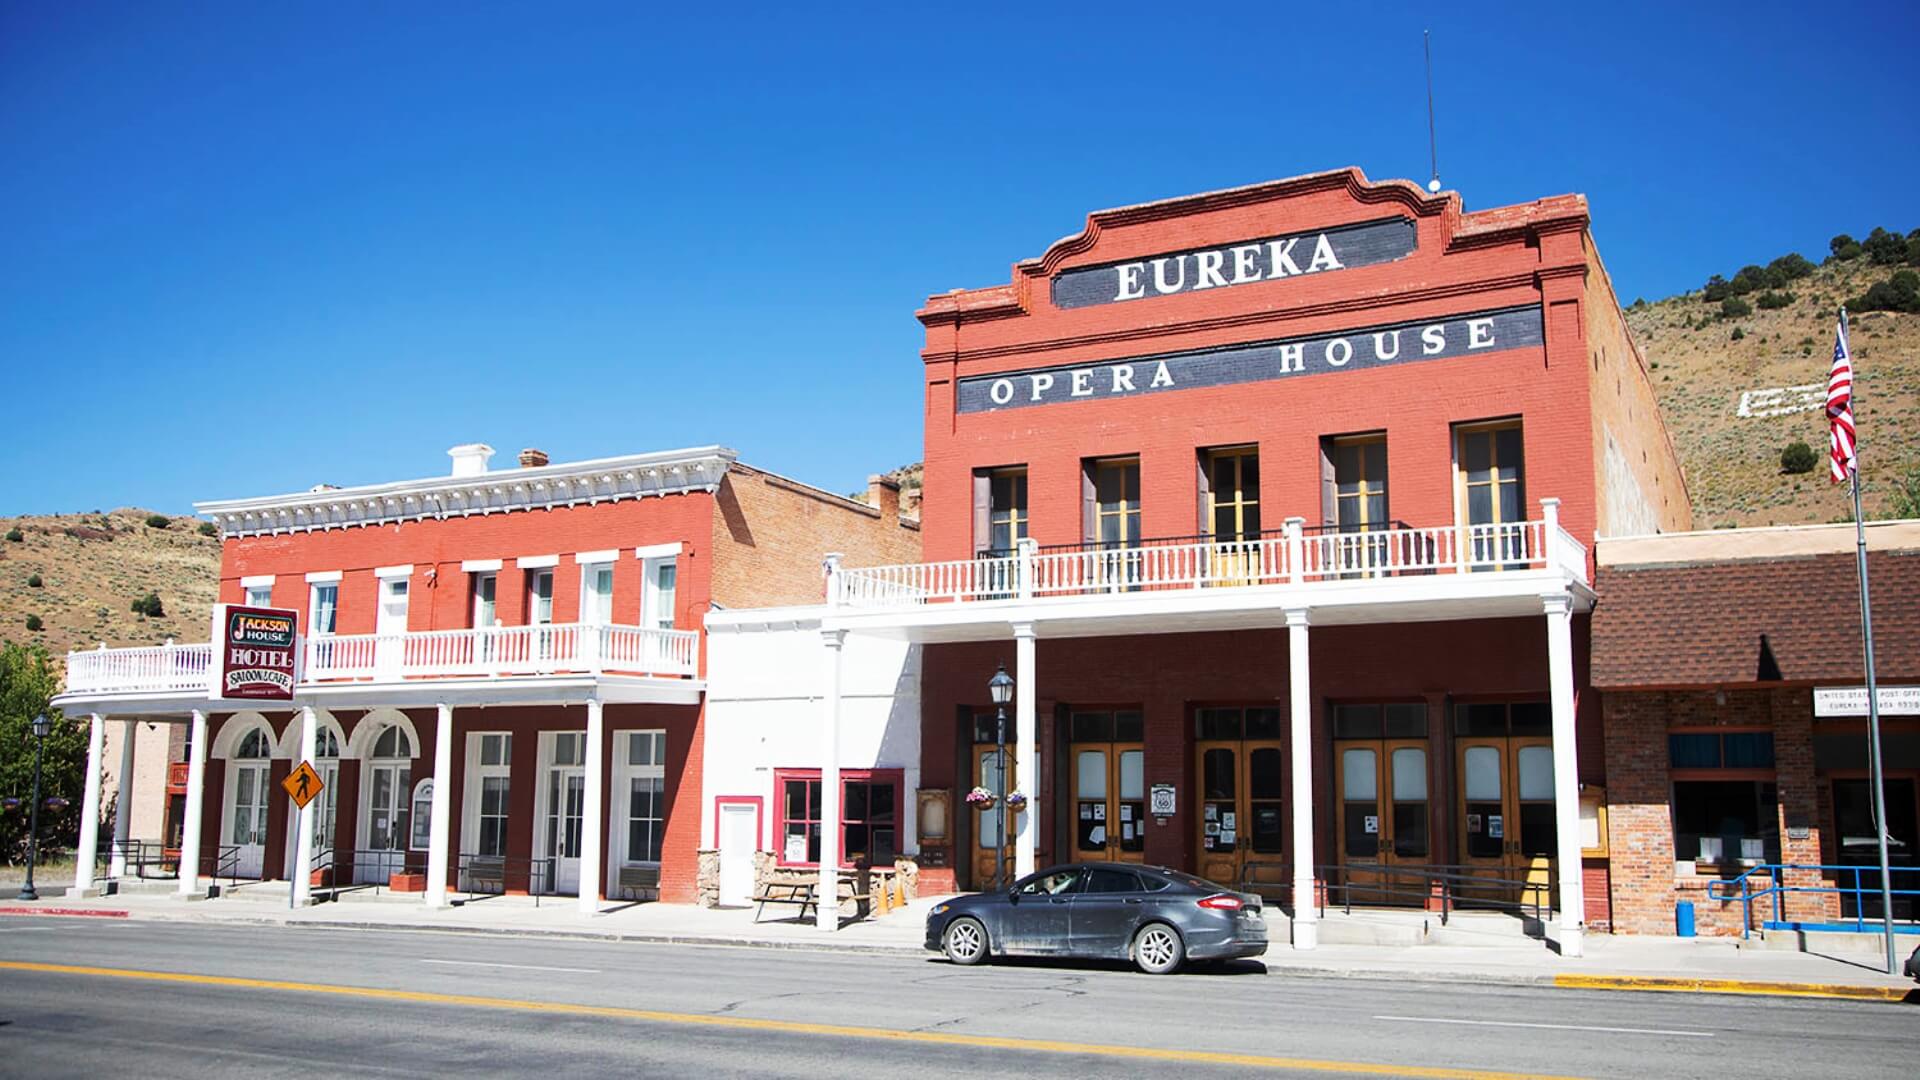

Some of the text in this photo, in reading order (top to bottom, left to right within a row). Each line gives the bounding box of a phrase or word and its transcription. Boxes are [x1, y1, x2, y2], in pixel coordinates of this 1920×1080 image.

[1114, 233, 1345, 302] EUREKA
[990, 317, 1496, 405] OPERA HOUSE
[234, 616, 289, 639] JACKSON
[247, 631, 286, 641] HOUSE
[231, 648, 293, 668] HOTEL
[230, 670, 262, 685] SALOON
[269, 672, 289, 687] CAFE
